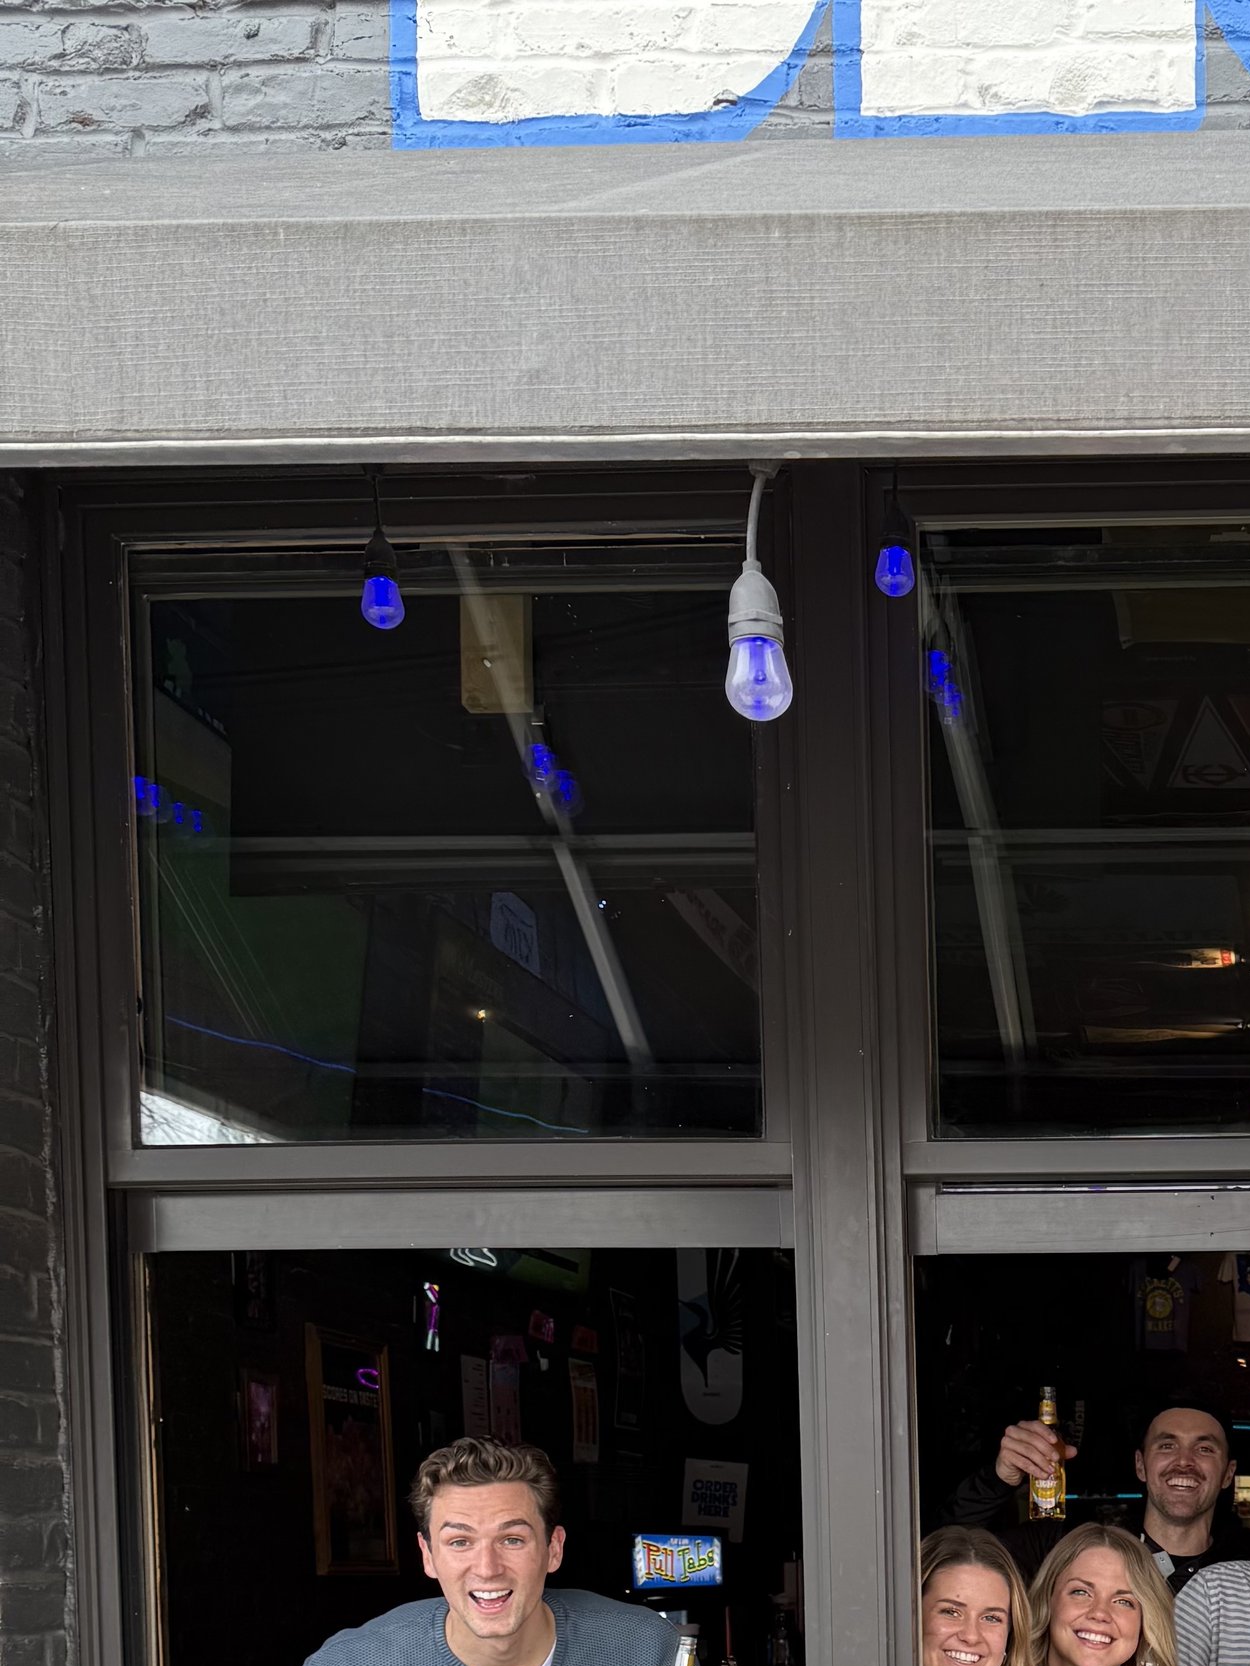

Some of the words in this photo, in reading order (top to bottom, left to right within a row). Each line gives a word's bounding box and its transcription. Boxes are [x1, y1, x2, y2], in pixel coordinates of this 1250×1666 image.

[693, 1480, 738, 1493] ORDER
[691, 1492, 738, 1506] DRINKS
[698, 1504, 730, 1517] HERE
[642, 1540, 676, 1582] Pull
[677, 1540, 715, 1583] Tabs
